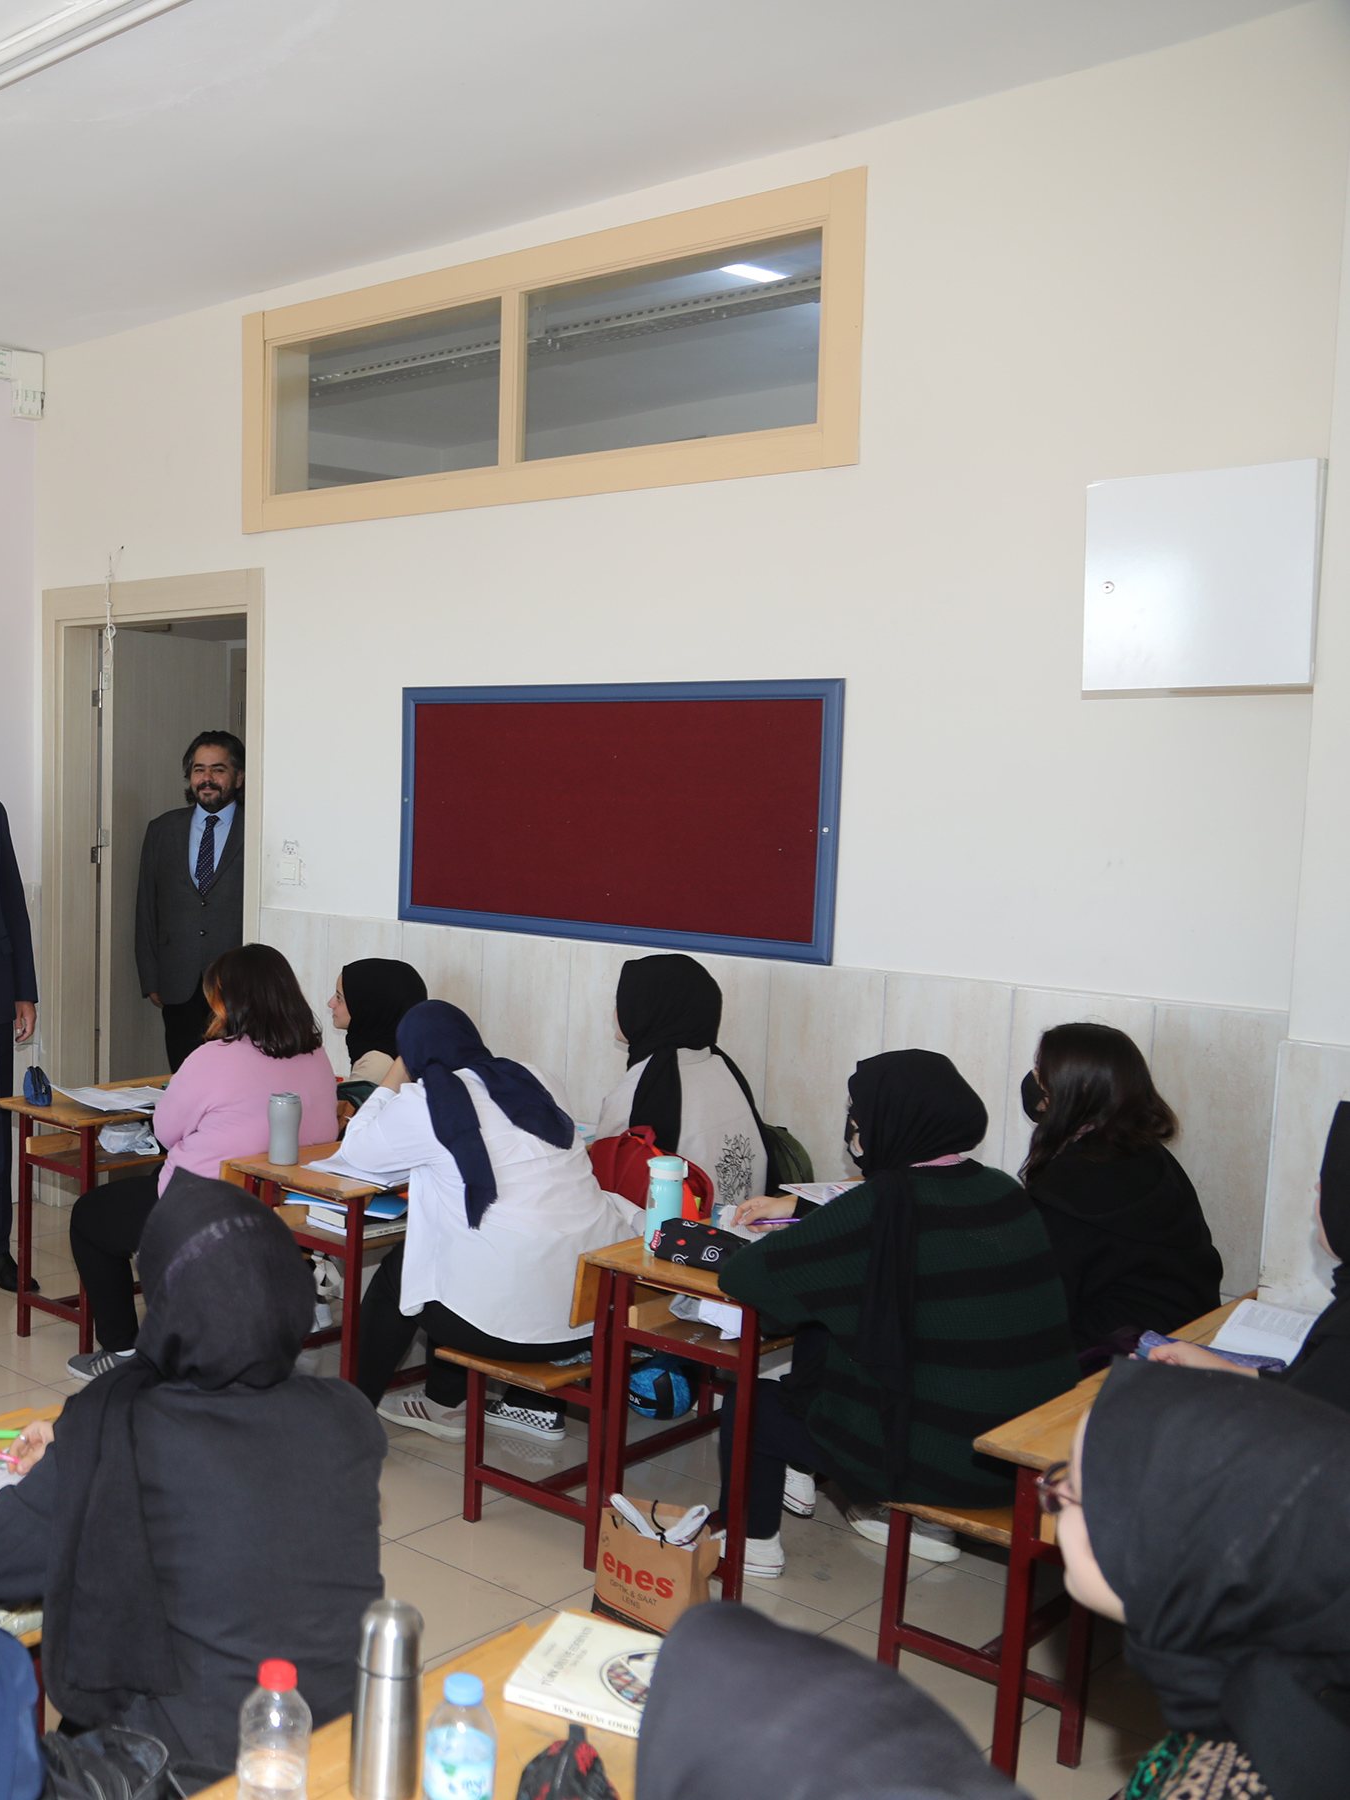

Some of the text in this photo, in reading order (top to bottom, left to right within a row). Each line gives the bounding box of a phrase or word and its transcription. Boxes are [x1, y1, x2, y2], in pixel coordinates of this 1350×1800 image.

[603, 1552, 674, 1599] enes
[622, 1595, 641, 1610] LENS
[630, 1590, 636, 1598] &
[638, 1594, 658, 1606] SAAT
